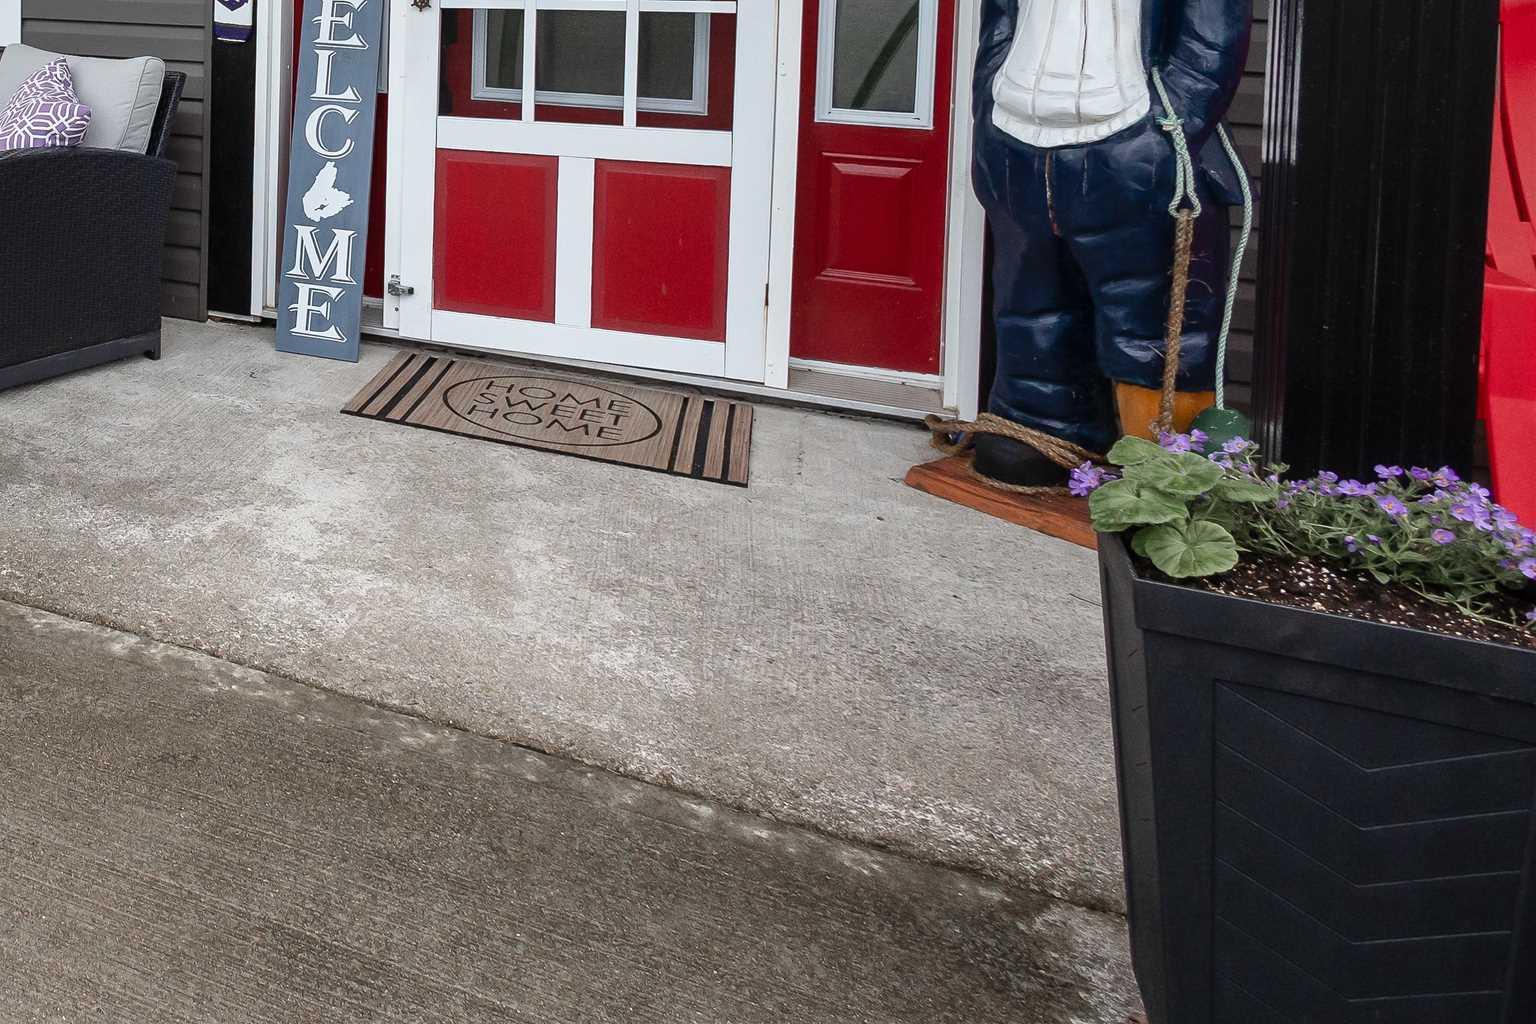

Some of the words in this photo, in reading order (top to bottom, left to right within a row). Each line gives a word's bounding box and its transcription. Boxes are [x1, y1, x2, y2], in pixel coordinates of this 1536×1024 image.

[473, 392, 625, 426] SWEET
[485, 380, 631, 413] HOME
[468, 404, 623, 441] HOME
